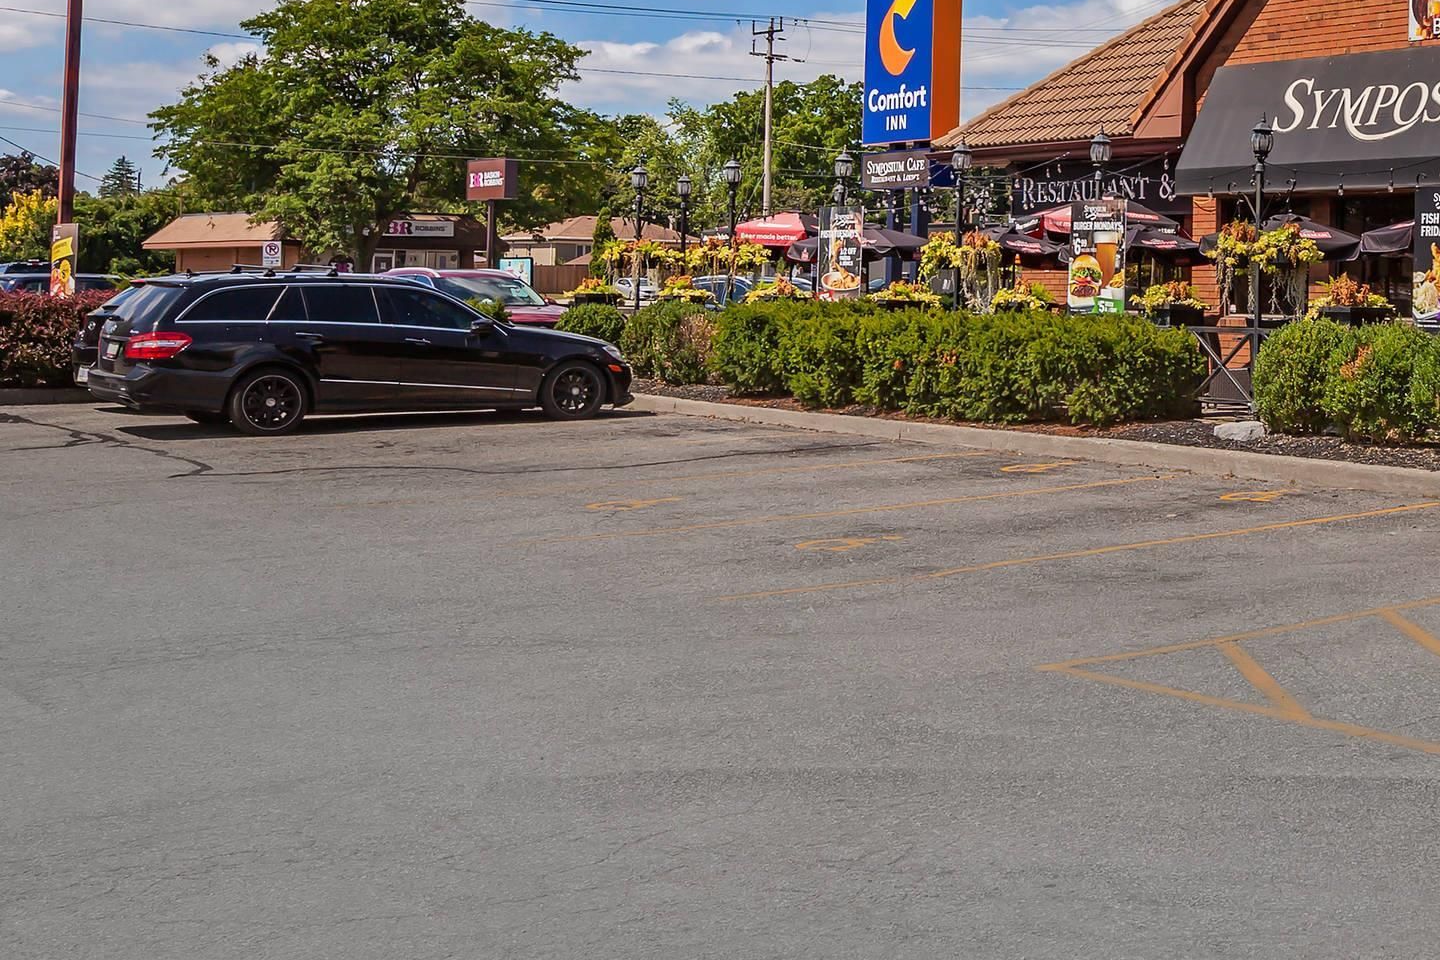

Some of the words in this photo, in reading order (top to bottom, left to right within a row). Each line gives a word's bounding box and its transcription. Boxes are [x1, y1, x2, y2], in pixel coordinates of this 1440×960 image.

[868, 83, 927, 112] Comfort
[886, 114, 907, 131] INN
[866, 160, 905, 176] SYMPOSIUM
[907, 157, 925, 171] CAFE
[1022, 176, 1150, 203] RESTAUANT
[1073, 221, 1093, 231] BURGER
[1094, 221, 1122, 231] MONDAYS
[1421, 213, 1440, 225] FISH
